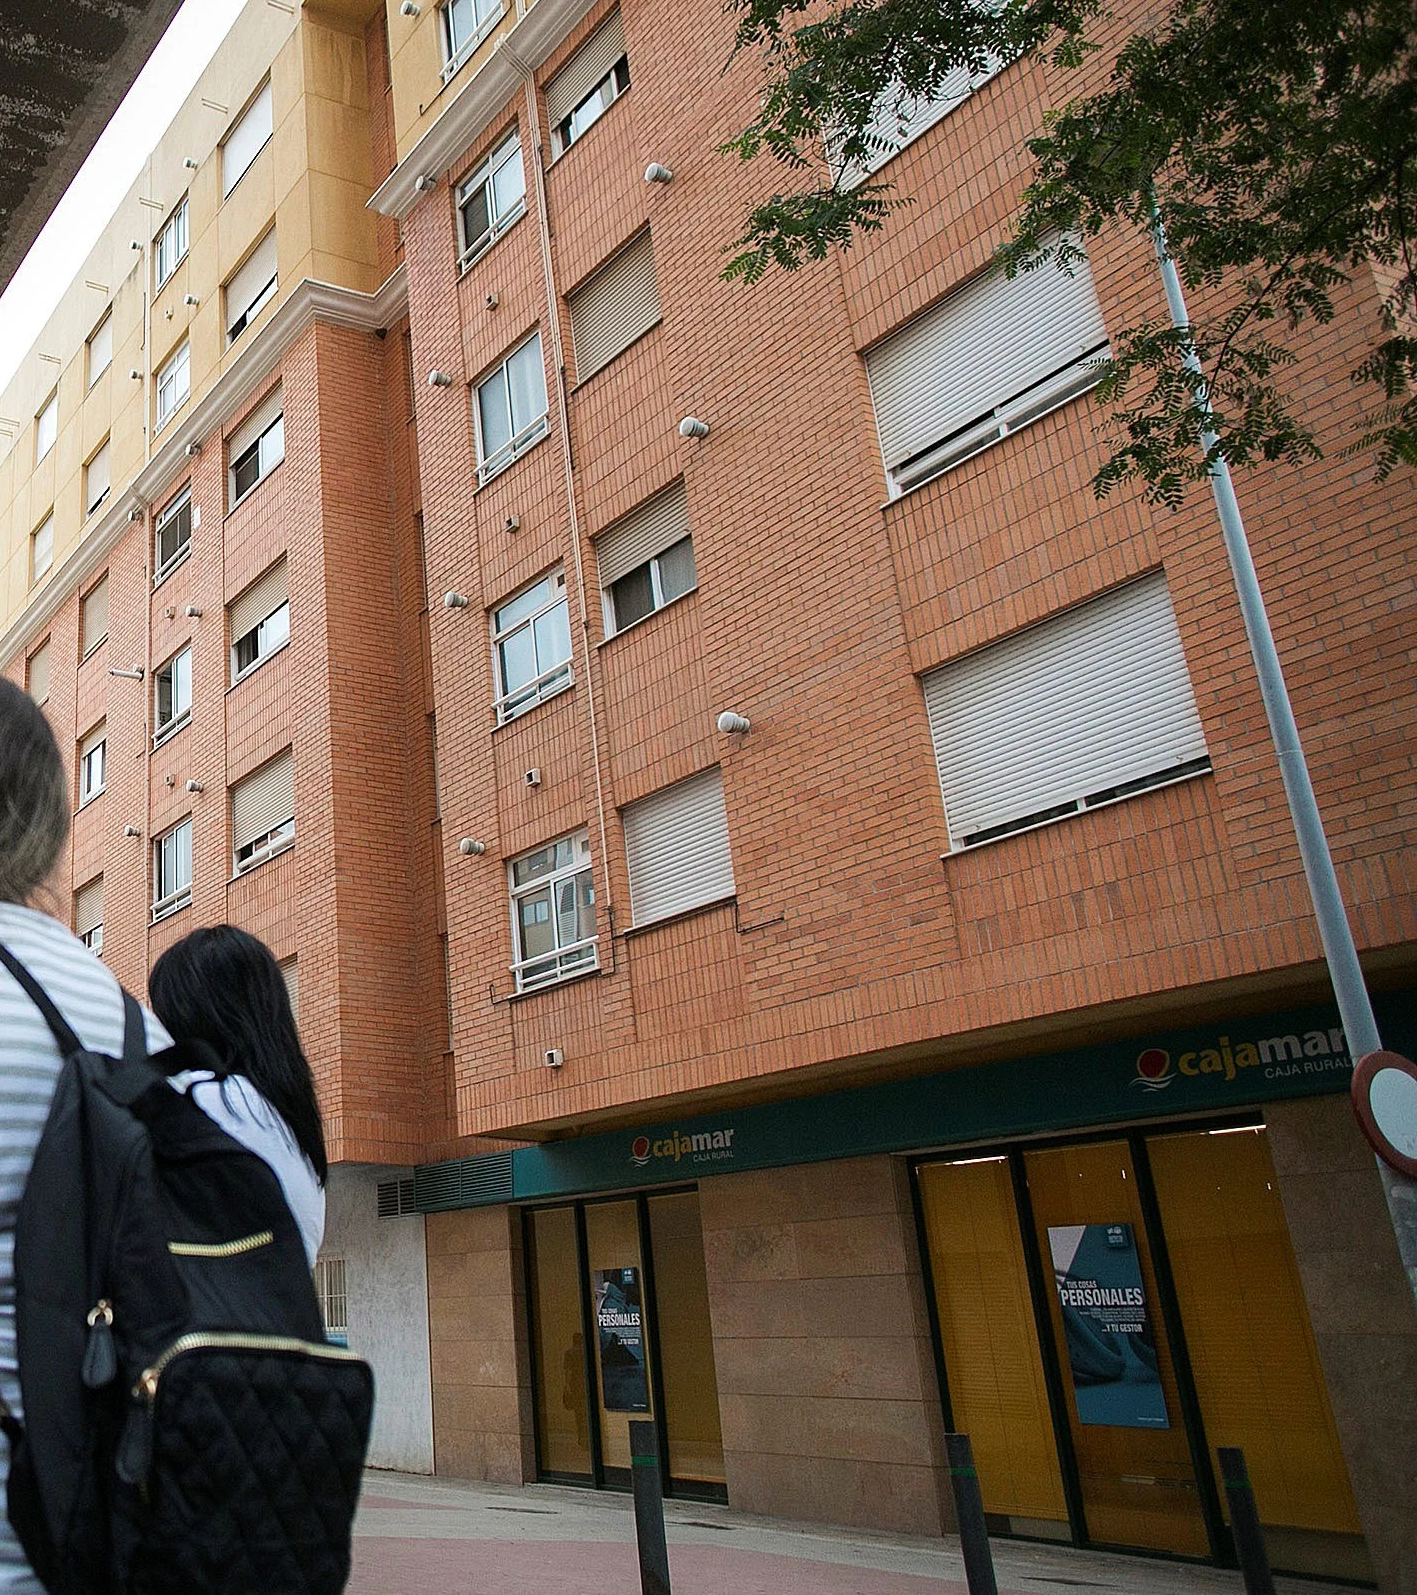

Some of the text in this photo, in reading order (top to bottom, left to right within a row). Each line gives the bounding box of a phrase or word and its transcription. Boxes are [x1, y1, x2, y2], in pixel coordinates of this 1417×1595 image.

[1178, 1028, 1350, 1081] cajamar
[1265, 1058, 1351, 1079] CAJA RURAL
[653, 1129, 734, 1162] cajamar
[694, 1150, 734, 1162] CAJA RURAL
[1060, 1288, 1143, 1306] PERSONALES
[599, 1313, 640, 1326] PERSONALES
[1120, 1323, 1143, 1333] GESTOR
